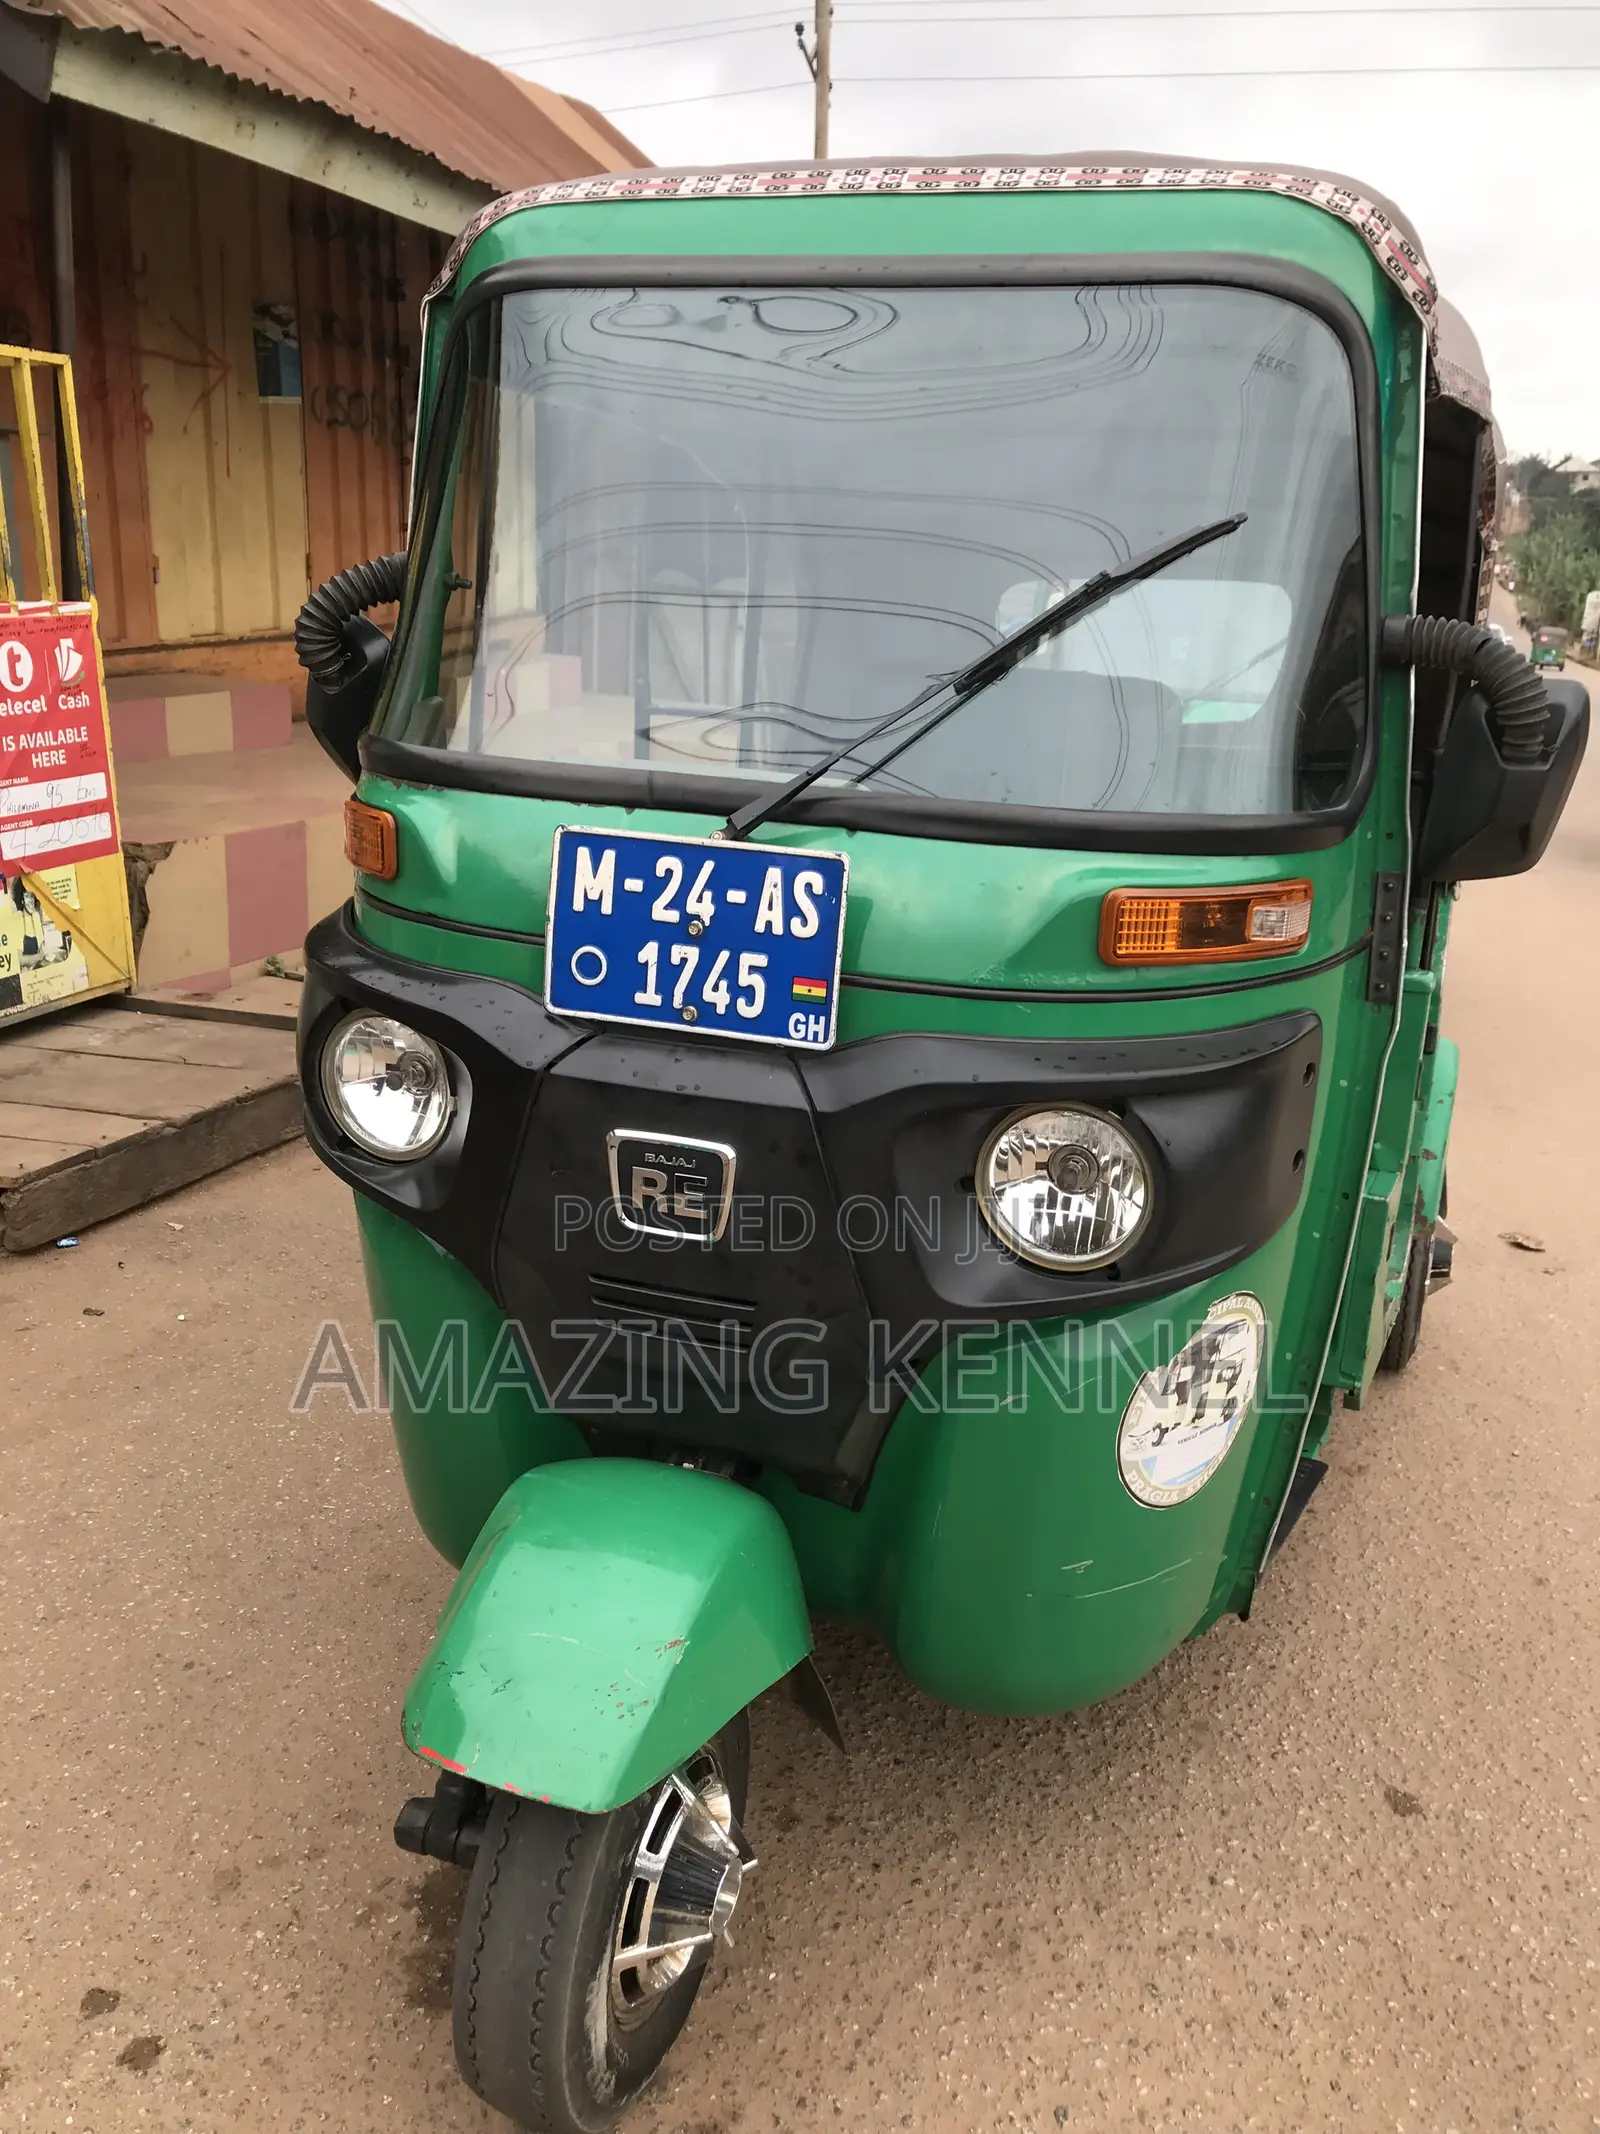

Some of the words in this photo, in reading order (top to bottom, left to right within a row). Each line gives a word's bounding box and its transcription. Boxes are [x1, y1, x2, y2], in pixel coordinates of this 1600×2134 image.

[58, 691, 90, 710] Cash
[2, 735, 16, 752] IS
[19, 726, 89, 750] AVAILABLE
[32, 749, 67, 768] HERE
[0, 822, 19, 832] AGENT
[18, 819, 33, 829] CODE
[572, 846, 824, 939] M-24-AS
[633, 940, 769, 1019] 1745
[788, 1012, 826, 1042] GH
[644, 1153, 696, 1169] BAJAJ
[631, 1165, 709, 1220] RE
